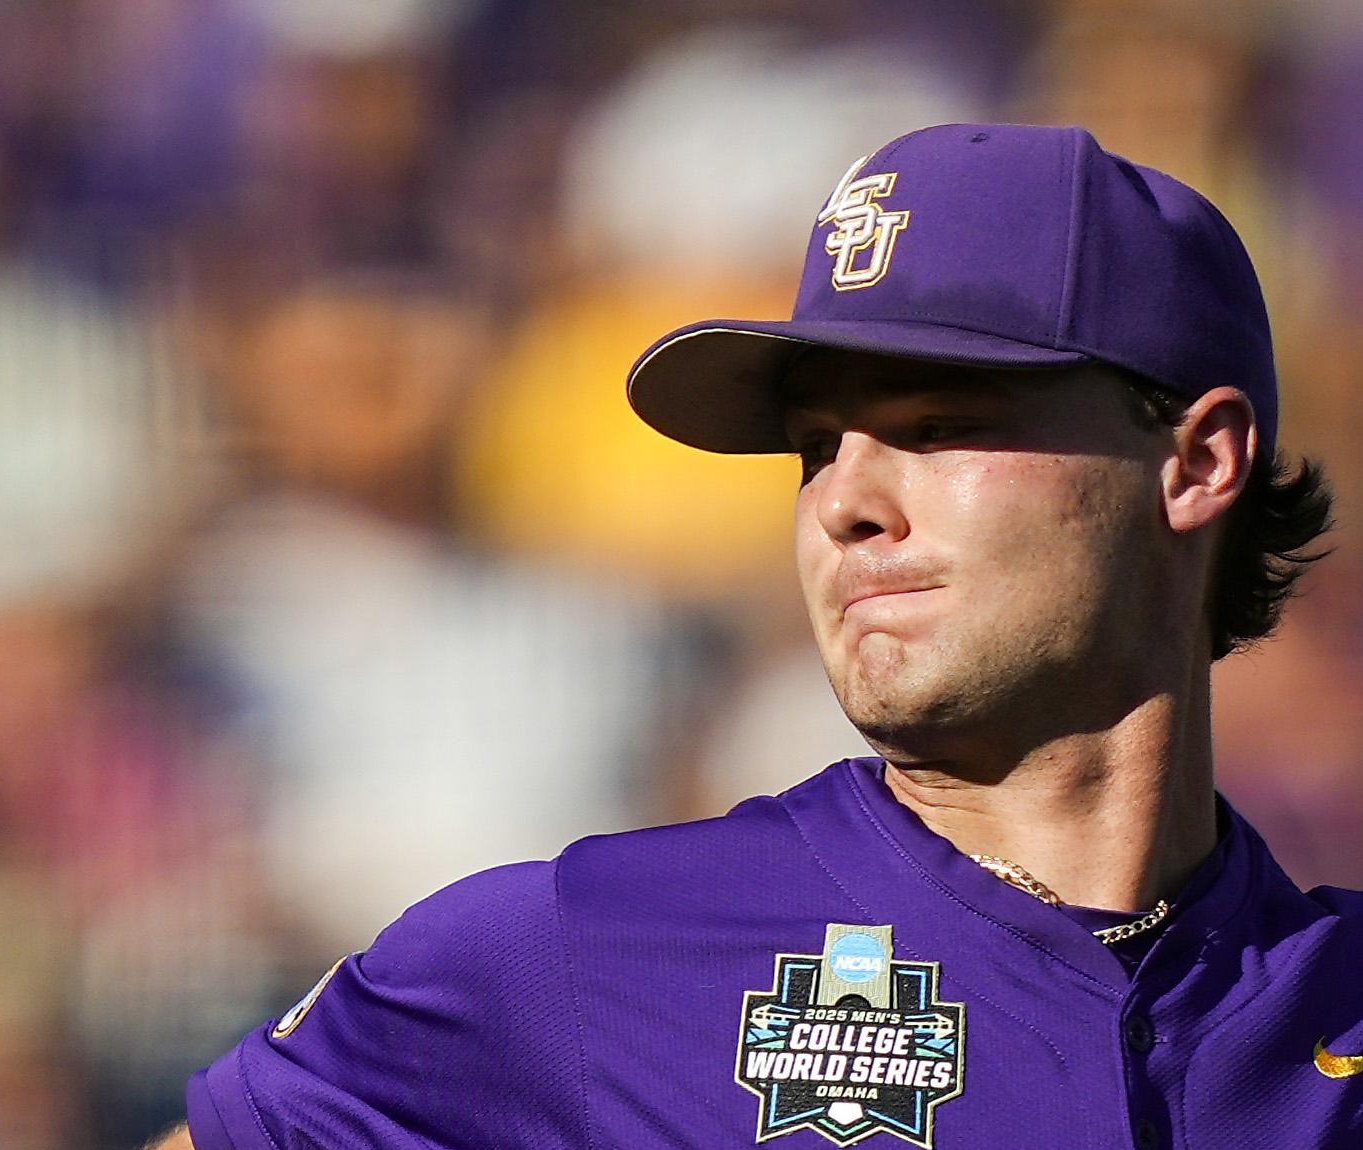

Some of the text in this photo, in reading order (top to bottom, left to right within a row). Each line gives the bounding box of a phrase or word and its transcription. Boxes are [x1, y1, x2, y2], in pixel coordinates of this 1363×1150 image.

[836, 954, 882, 971] NCAA
[804, 1009, 901, 1023] 2025 MEN'S
[789, 1023, 913, 1055] COLLEGE
[745, 1050, 954, 1089] WORLD SERIES
[816, 1085, 878, 1100] OMAHA
